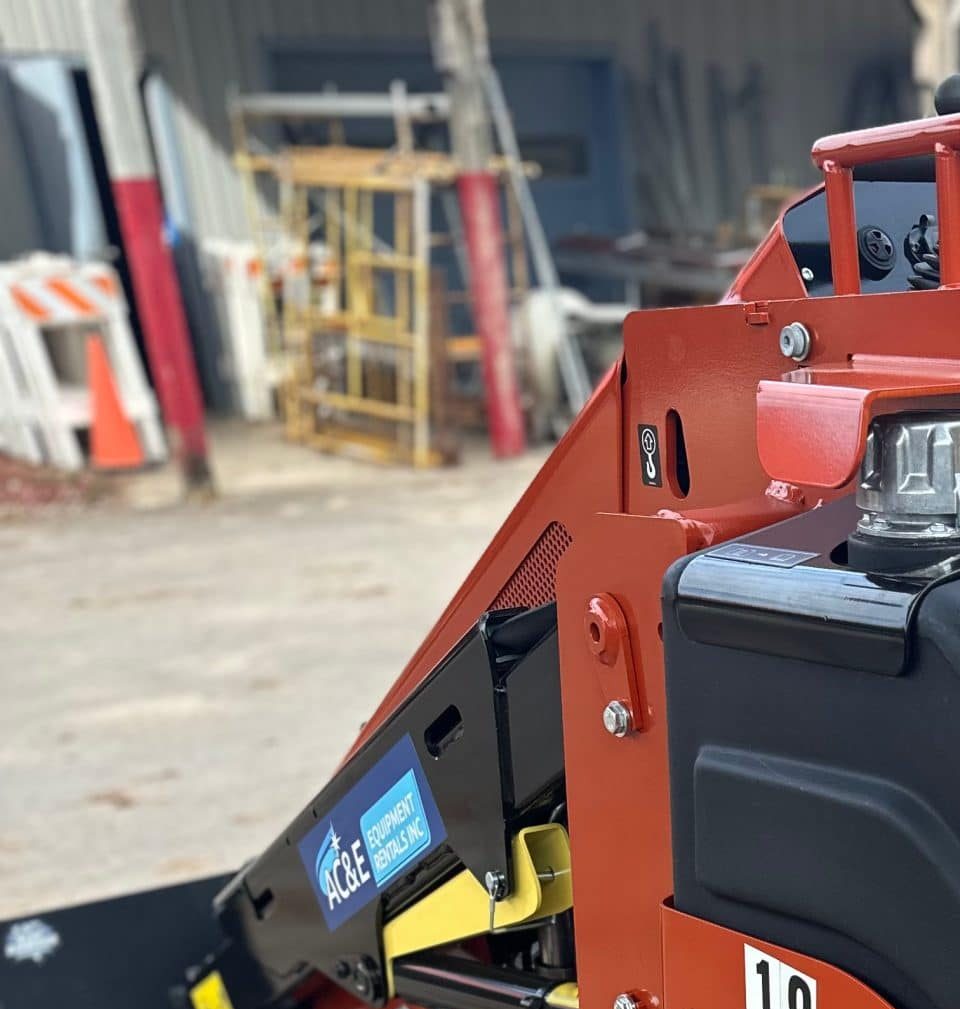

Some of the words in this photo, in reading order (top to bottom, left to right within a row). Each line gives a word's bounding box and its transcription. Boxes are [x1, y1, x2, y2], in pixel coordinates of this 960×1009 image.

[367, 792, 414, 848] EQUIPMENT
[373, 831, 409, 869] RENTALS
[406, 817, 424, 844] INC
[324, 839, 370, 910] AC&E
